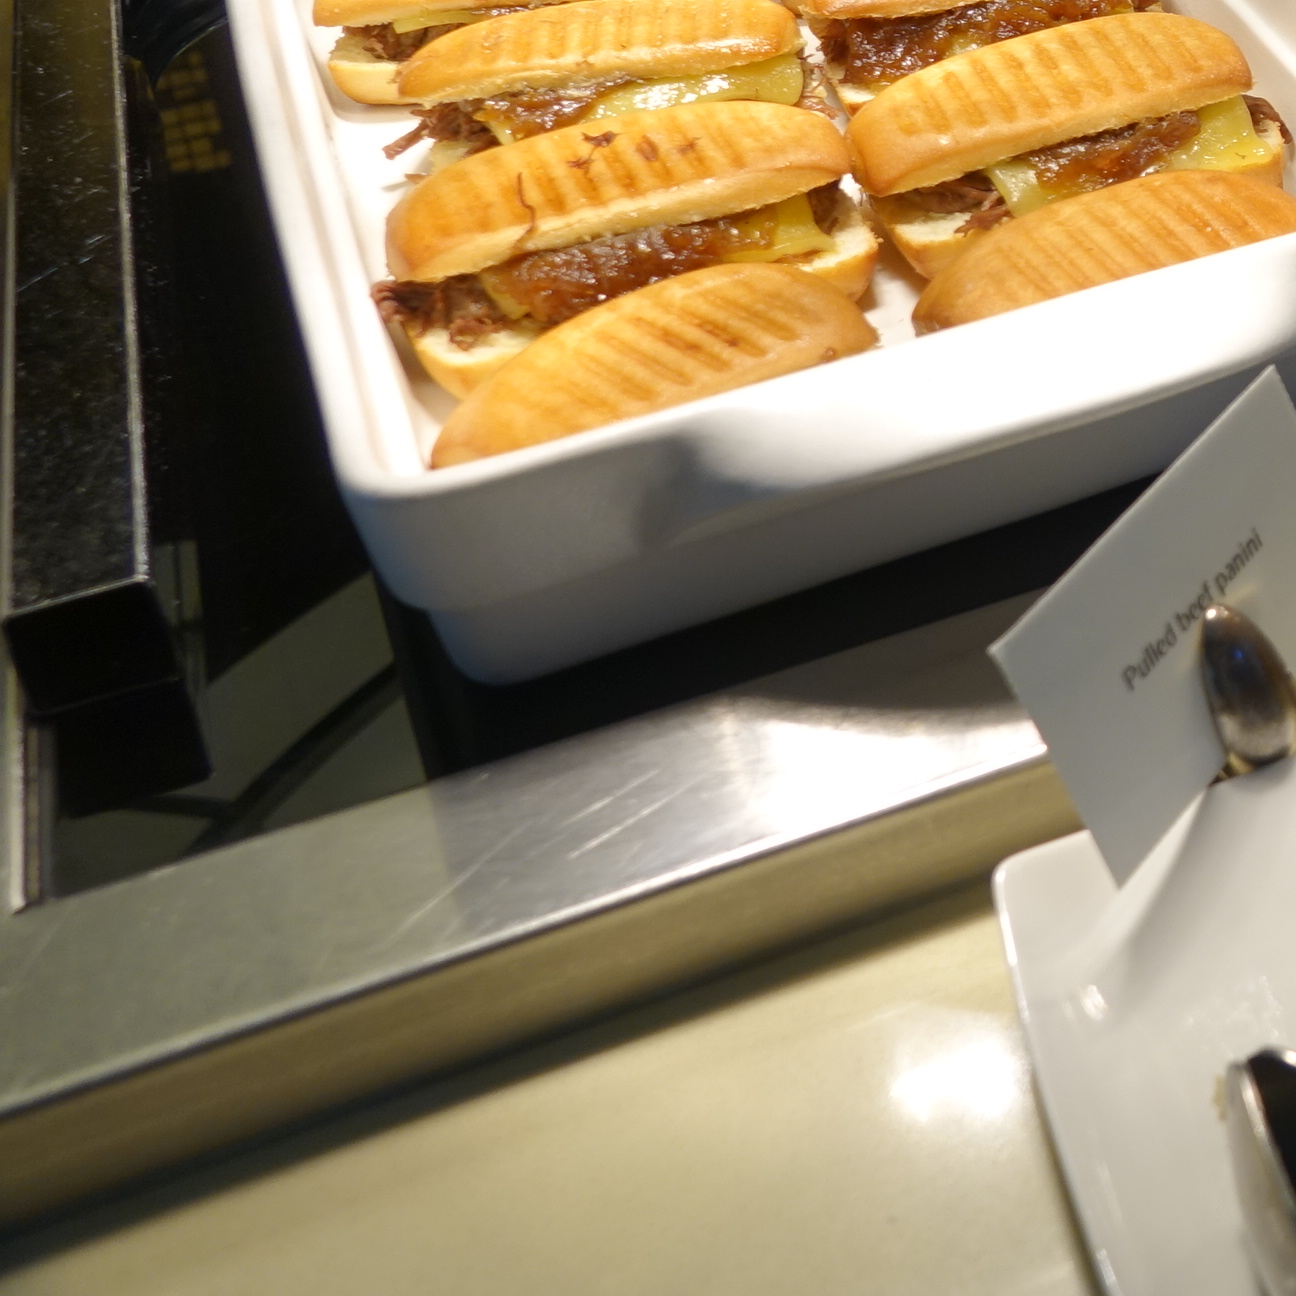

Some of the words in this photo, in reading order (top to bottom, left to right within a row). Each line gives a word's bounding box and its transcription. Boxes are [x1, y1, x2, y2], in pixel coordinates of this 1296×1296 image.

[1121, 622, 1178, 691] Pulled
[1175, 579, 1214, 632] beef
[1214, 526, 1264, 597] panini
